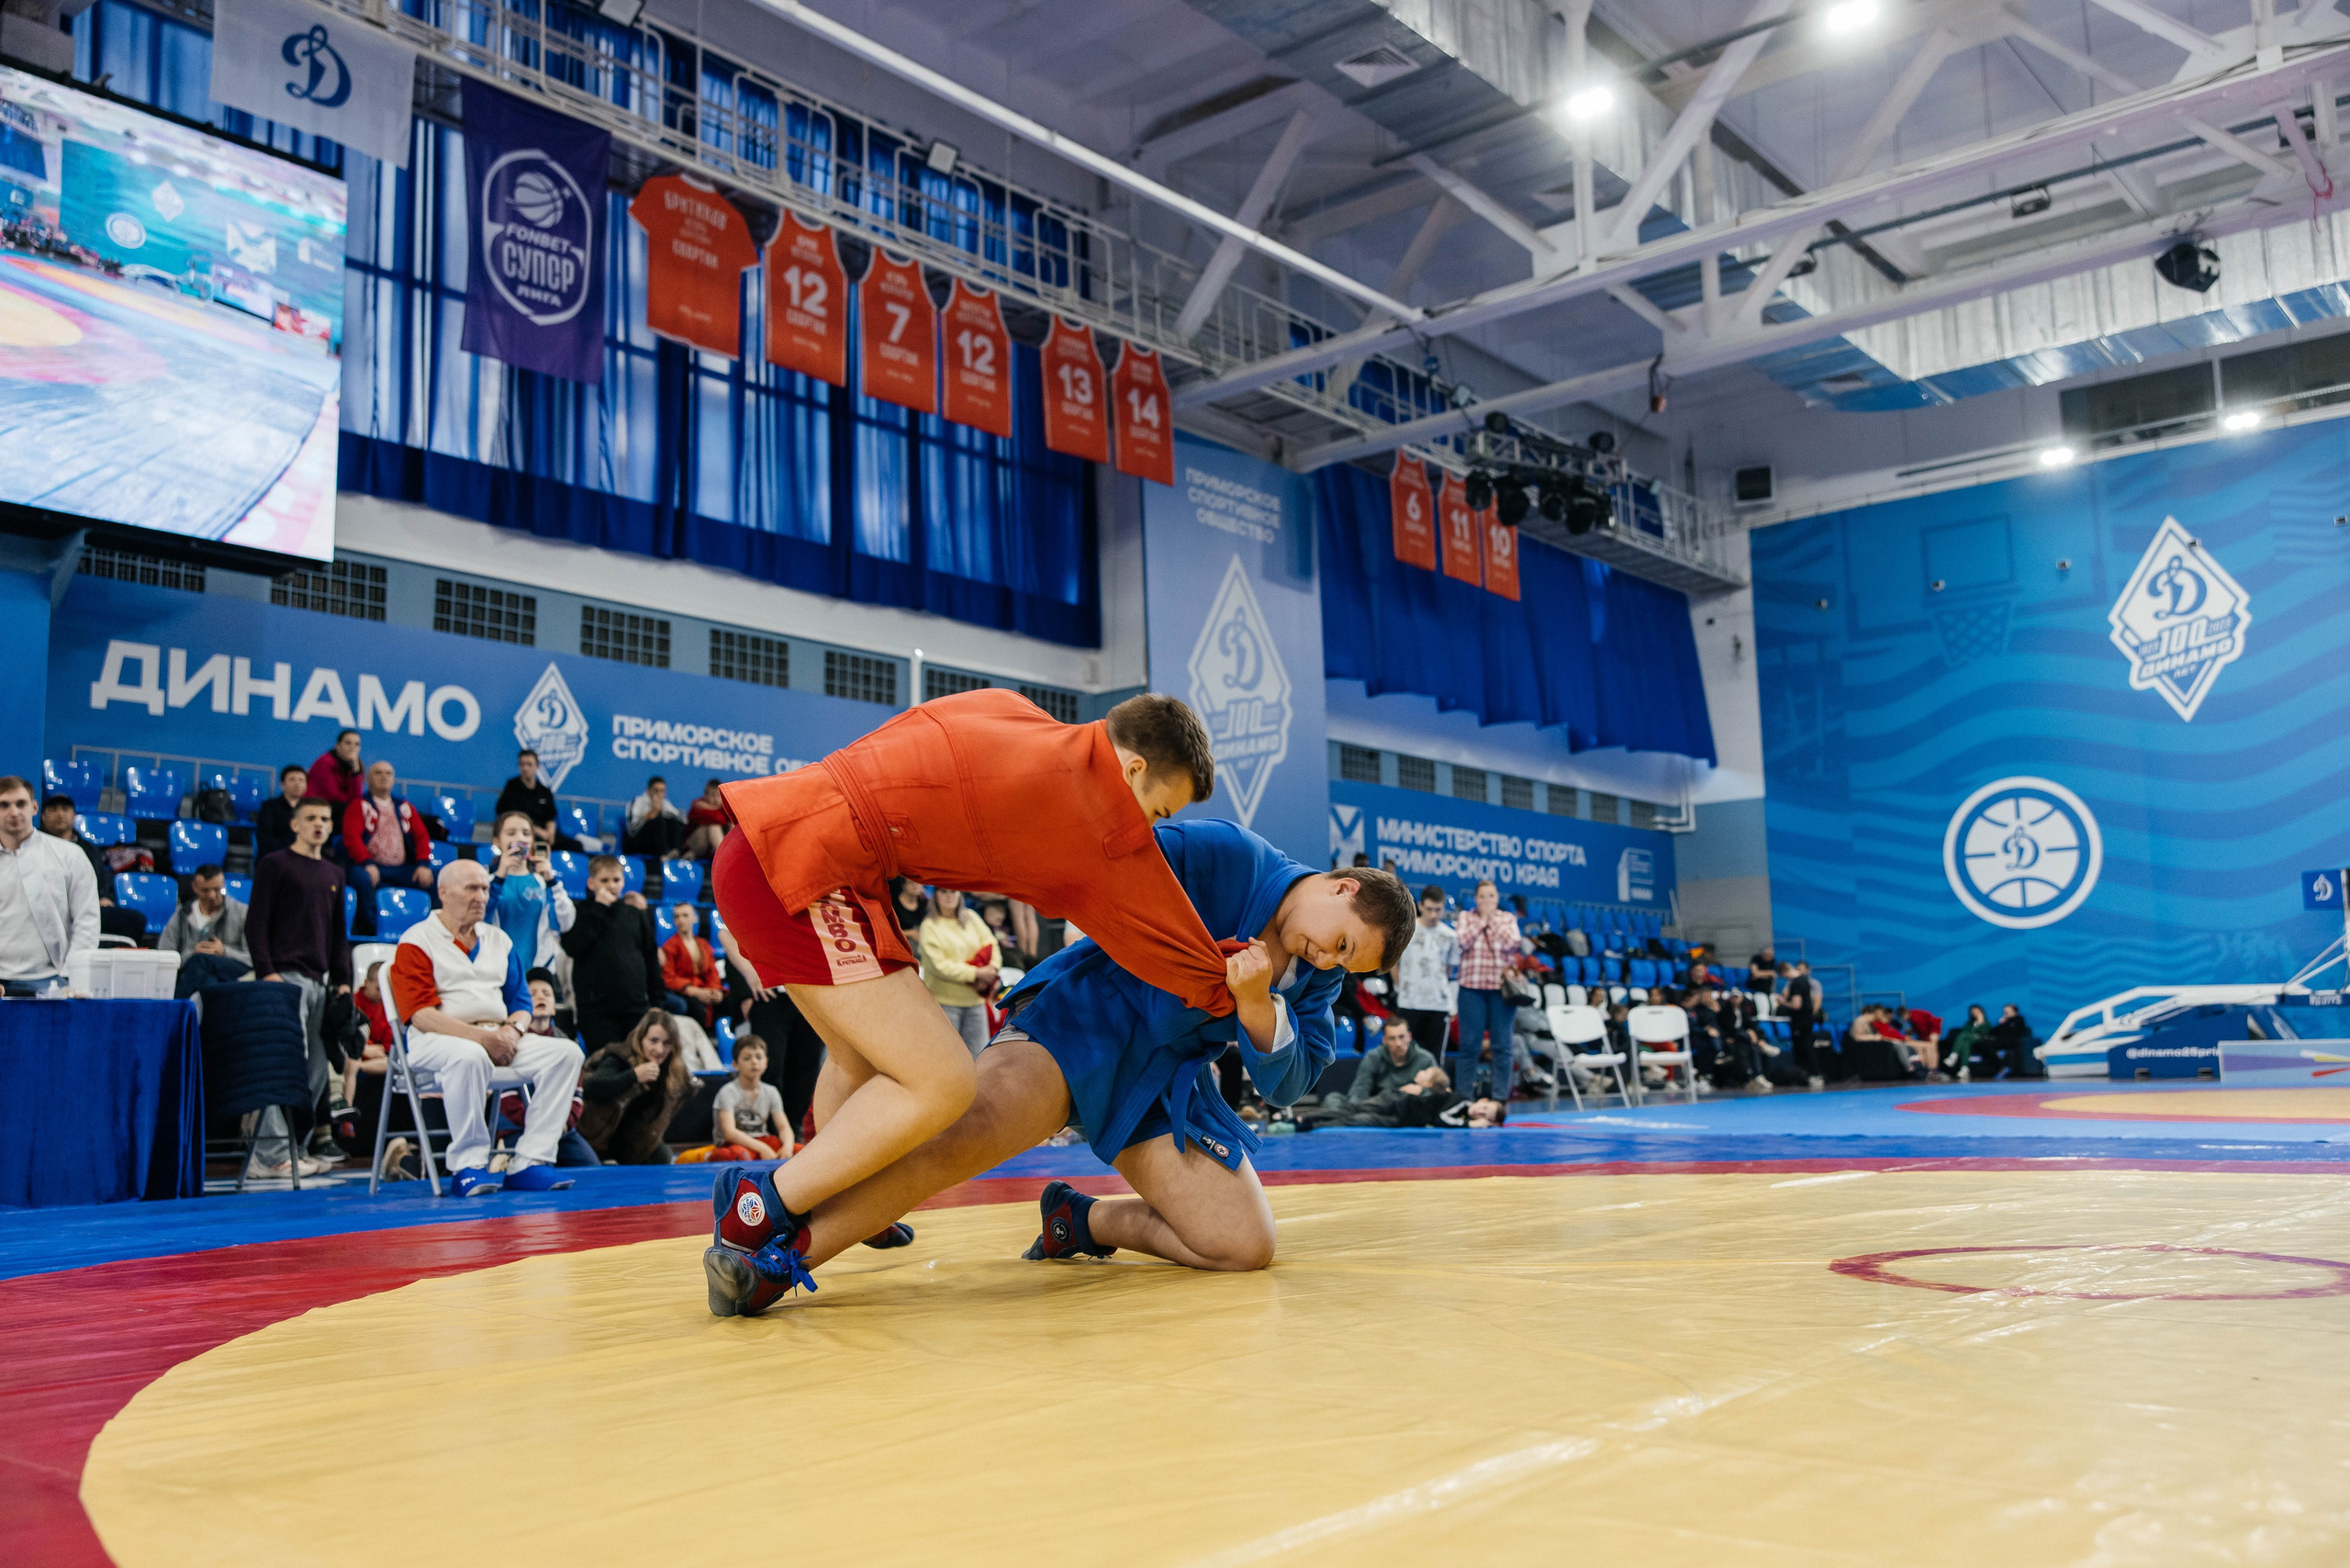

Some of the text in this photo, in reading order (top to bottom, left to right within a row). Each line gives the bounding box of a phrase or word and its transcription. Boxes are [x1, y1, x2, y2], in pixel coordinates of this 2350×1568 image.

[505, 222, 572, 253] FONBET
[783, 265, 828, 318] 12
[885, 302, 912, 343] 7
[957, 330, 997, 375] 12
[1058, 364, 1094, 405] 13
[1127, 388, 1160, 430] 14
[1406, 491, 1421, 521] 6
[1450, 509, 1471, 542] 11
[2148, 619, 2223, 661] 100
[90, 639, 482, 742] ДИНАМО
[612, 713, 774, 756] ПРИМОРСКОЕ
[611, 736, 771, 776] СПОРТИВНОЕ
[1376, 815, 1523, 858] МИНИСТЕРСТВО
[1525, 837, 1587, 868] СПОРТА
[1377, 845, 1561, 889] ПРИМОРСКОГО КРАЯ
